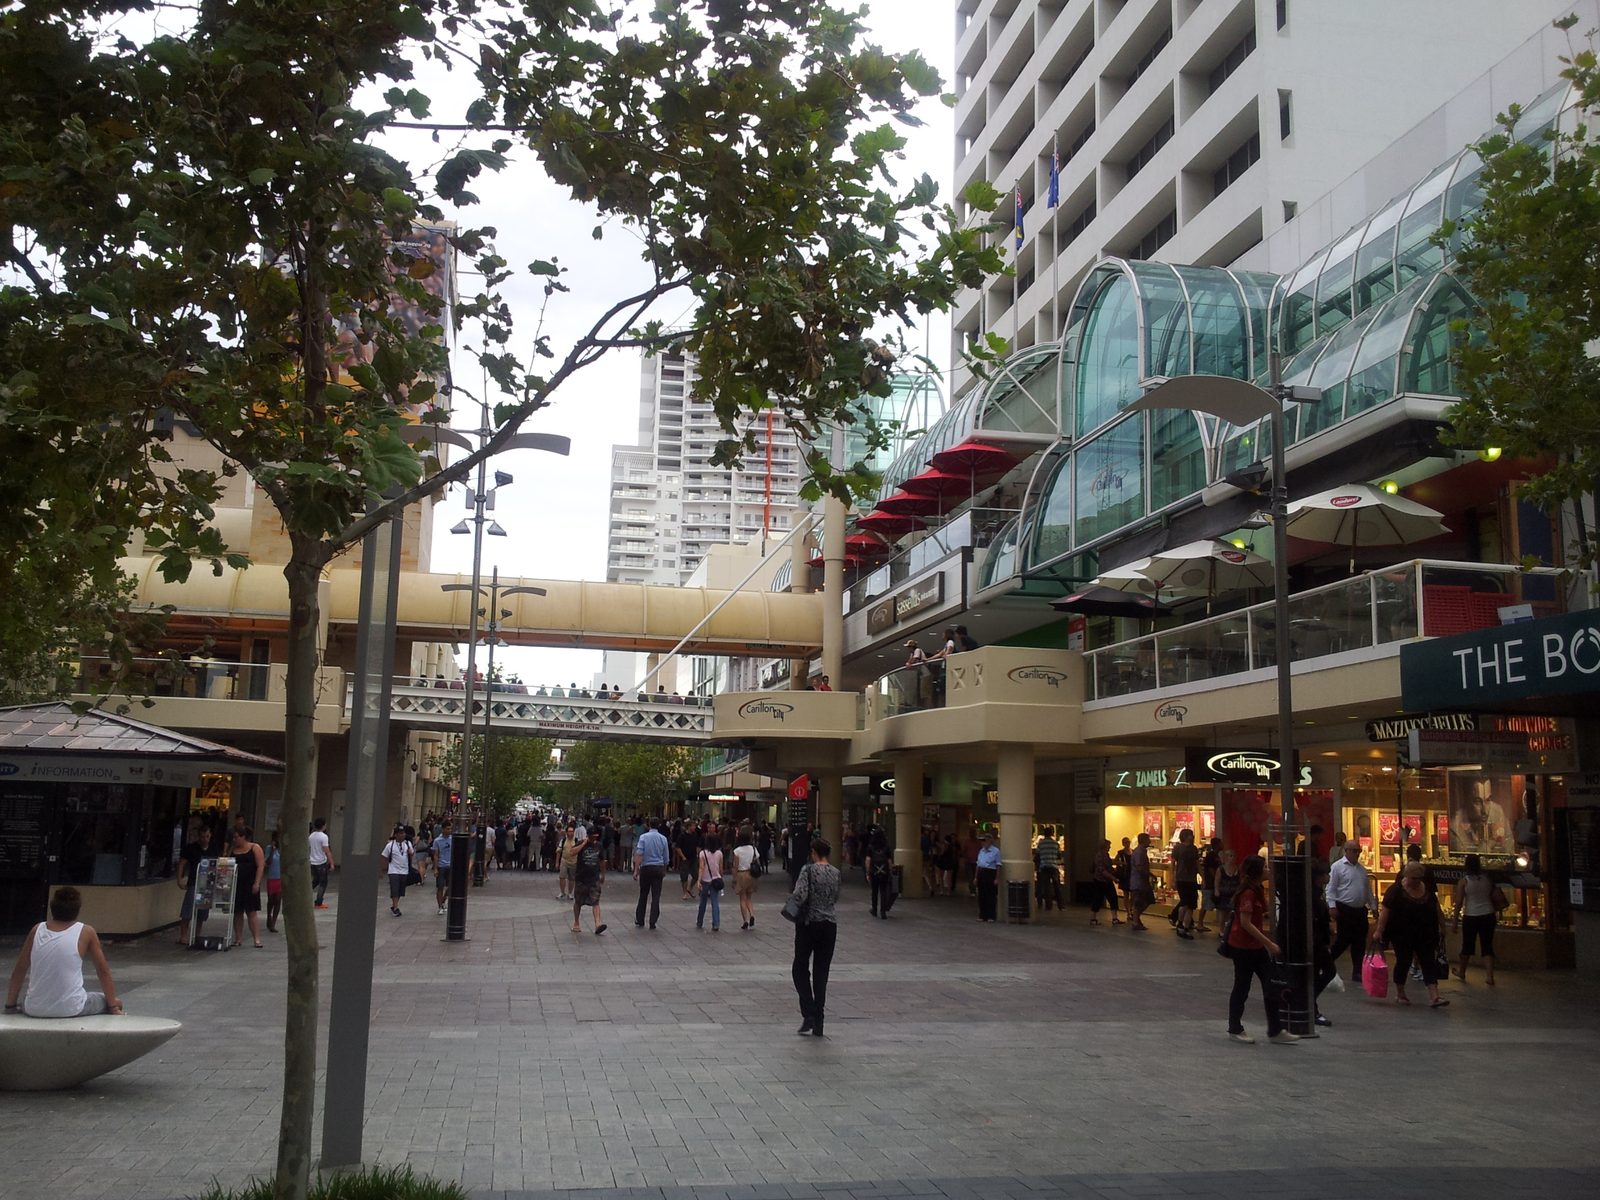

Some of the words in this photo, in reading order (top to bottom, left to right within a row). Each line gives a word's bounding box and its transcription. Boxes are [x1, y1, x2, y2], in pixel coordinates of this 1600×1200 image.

[1452, 638, 1526, 689] THE
[1018, 668, 1049, 680] Carillon
[746, 701, 774, 714] Carillon
[1220, 755, 1258, 770] Carillon
[1256, 764, 1270, 780] City
[1136, 769, 1168, 788] ZAMELS
